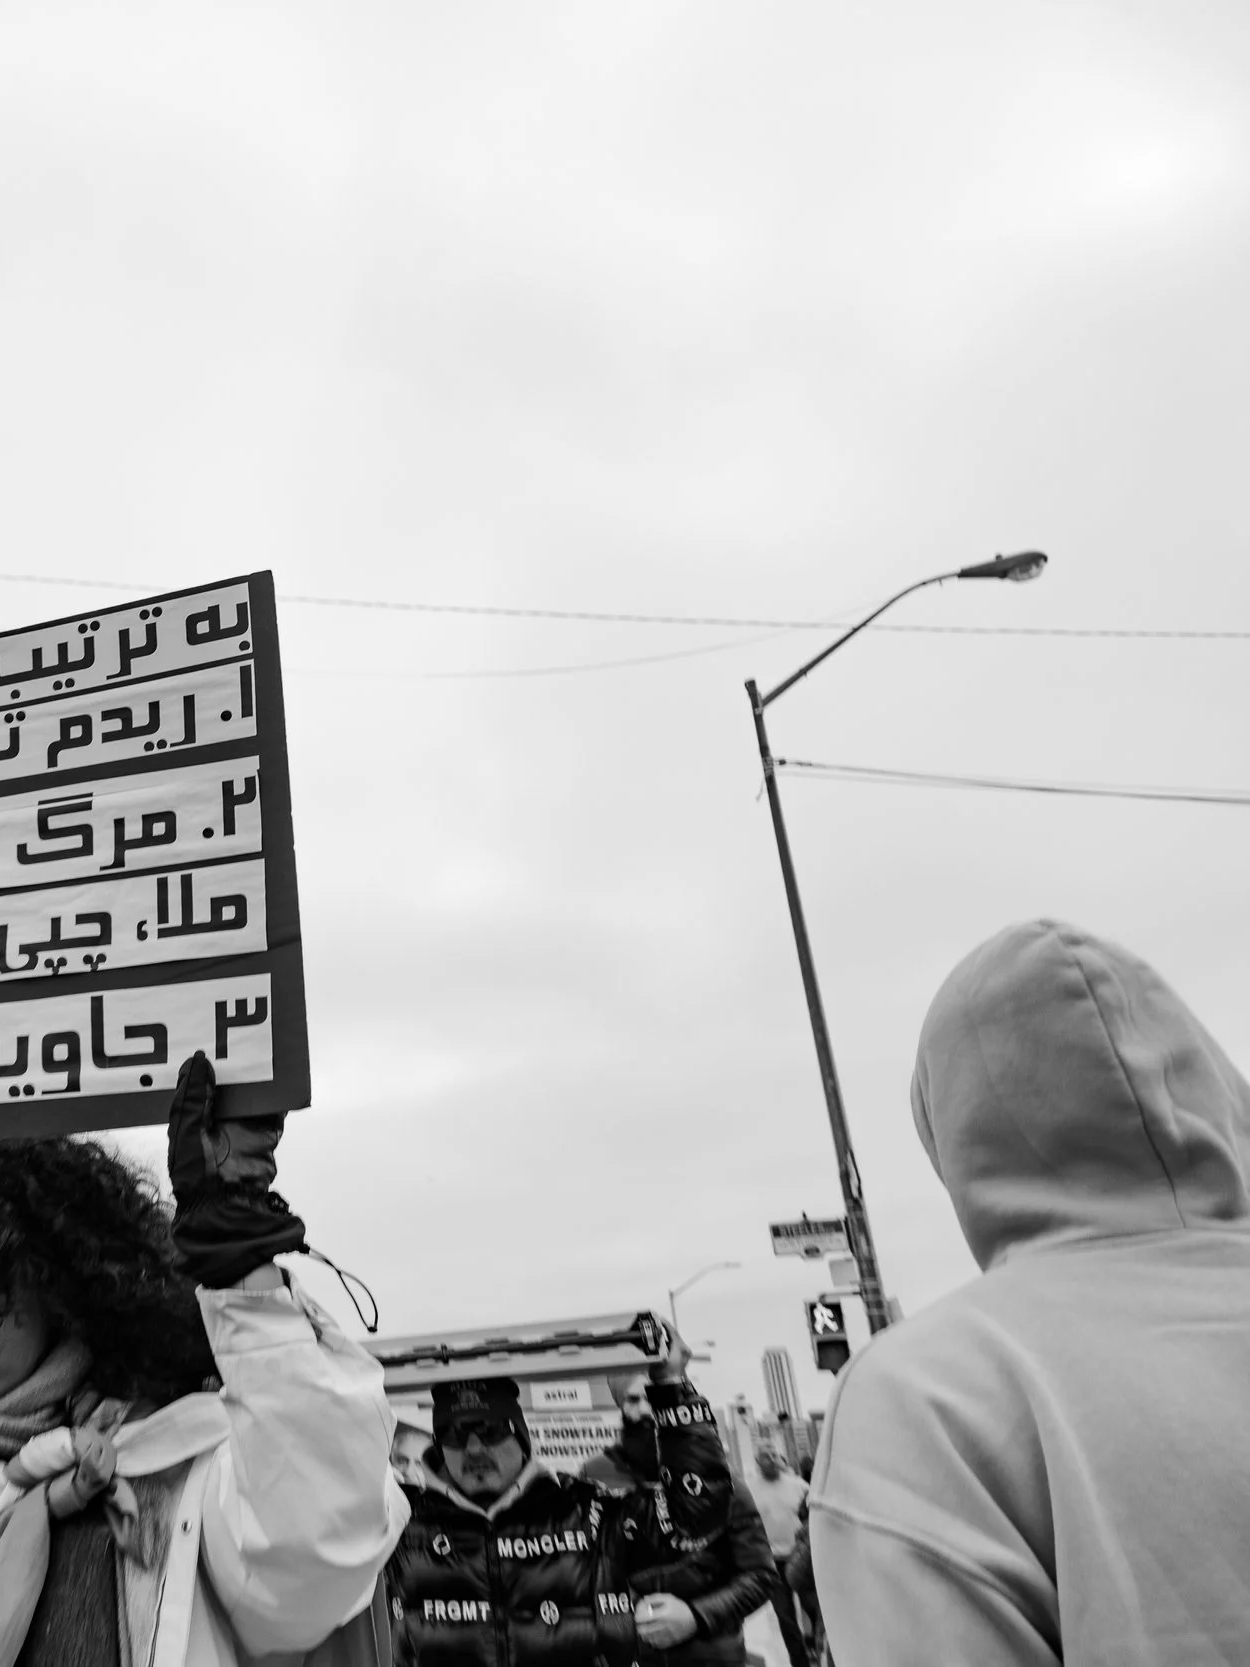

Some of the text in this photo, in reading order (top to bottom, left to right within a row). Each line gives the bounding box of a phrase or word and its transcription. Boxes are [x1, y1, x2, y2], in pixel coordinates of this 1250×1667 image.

[186, 602, 250, 652] به
[47, 694, 196, 769] ریدم
[17, 792, 176, 871] مرگ
[137, 873, 247, 941] ملا،
